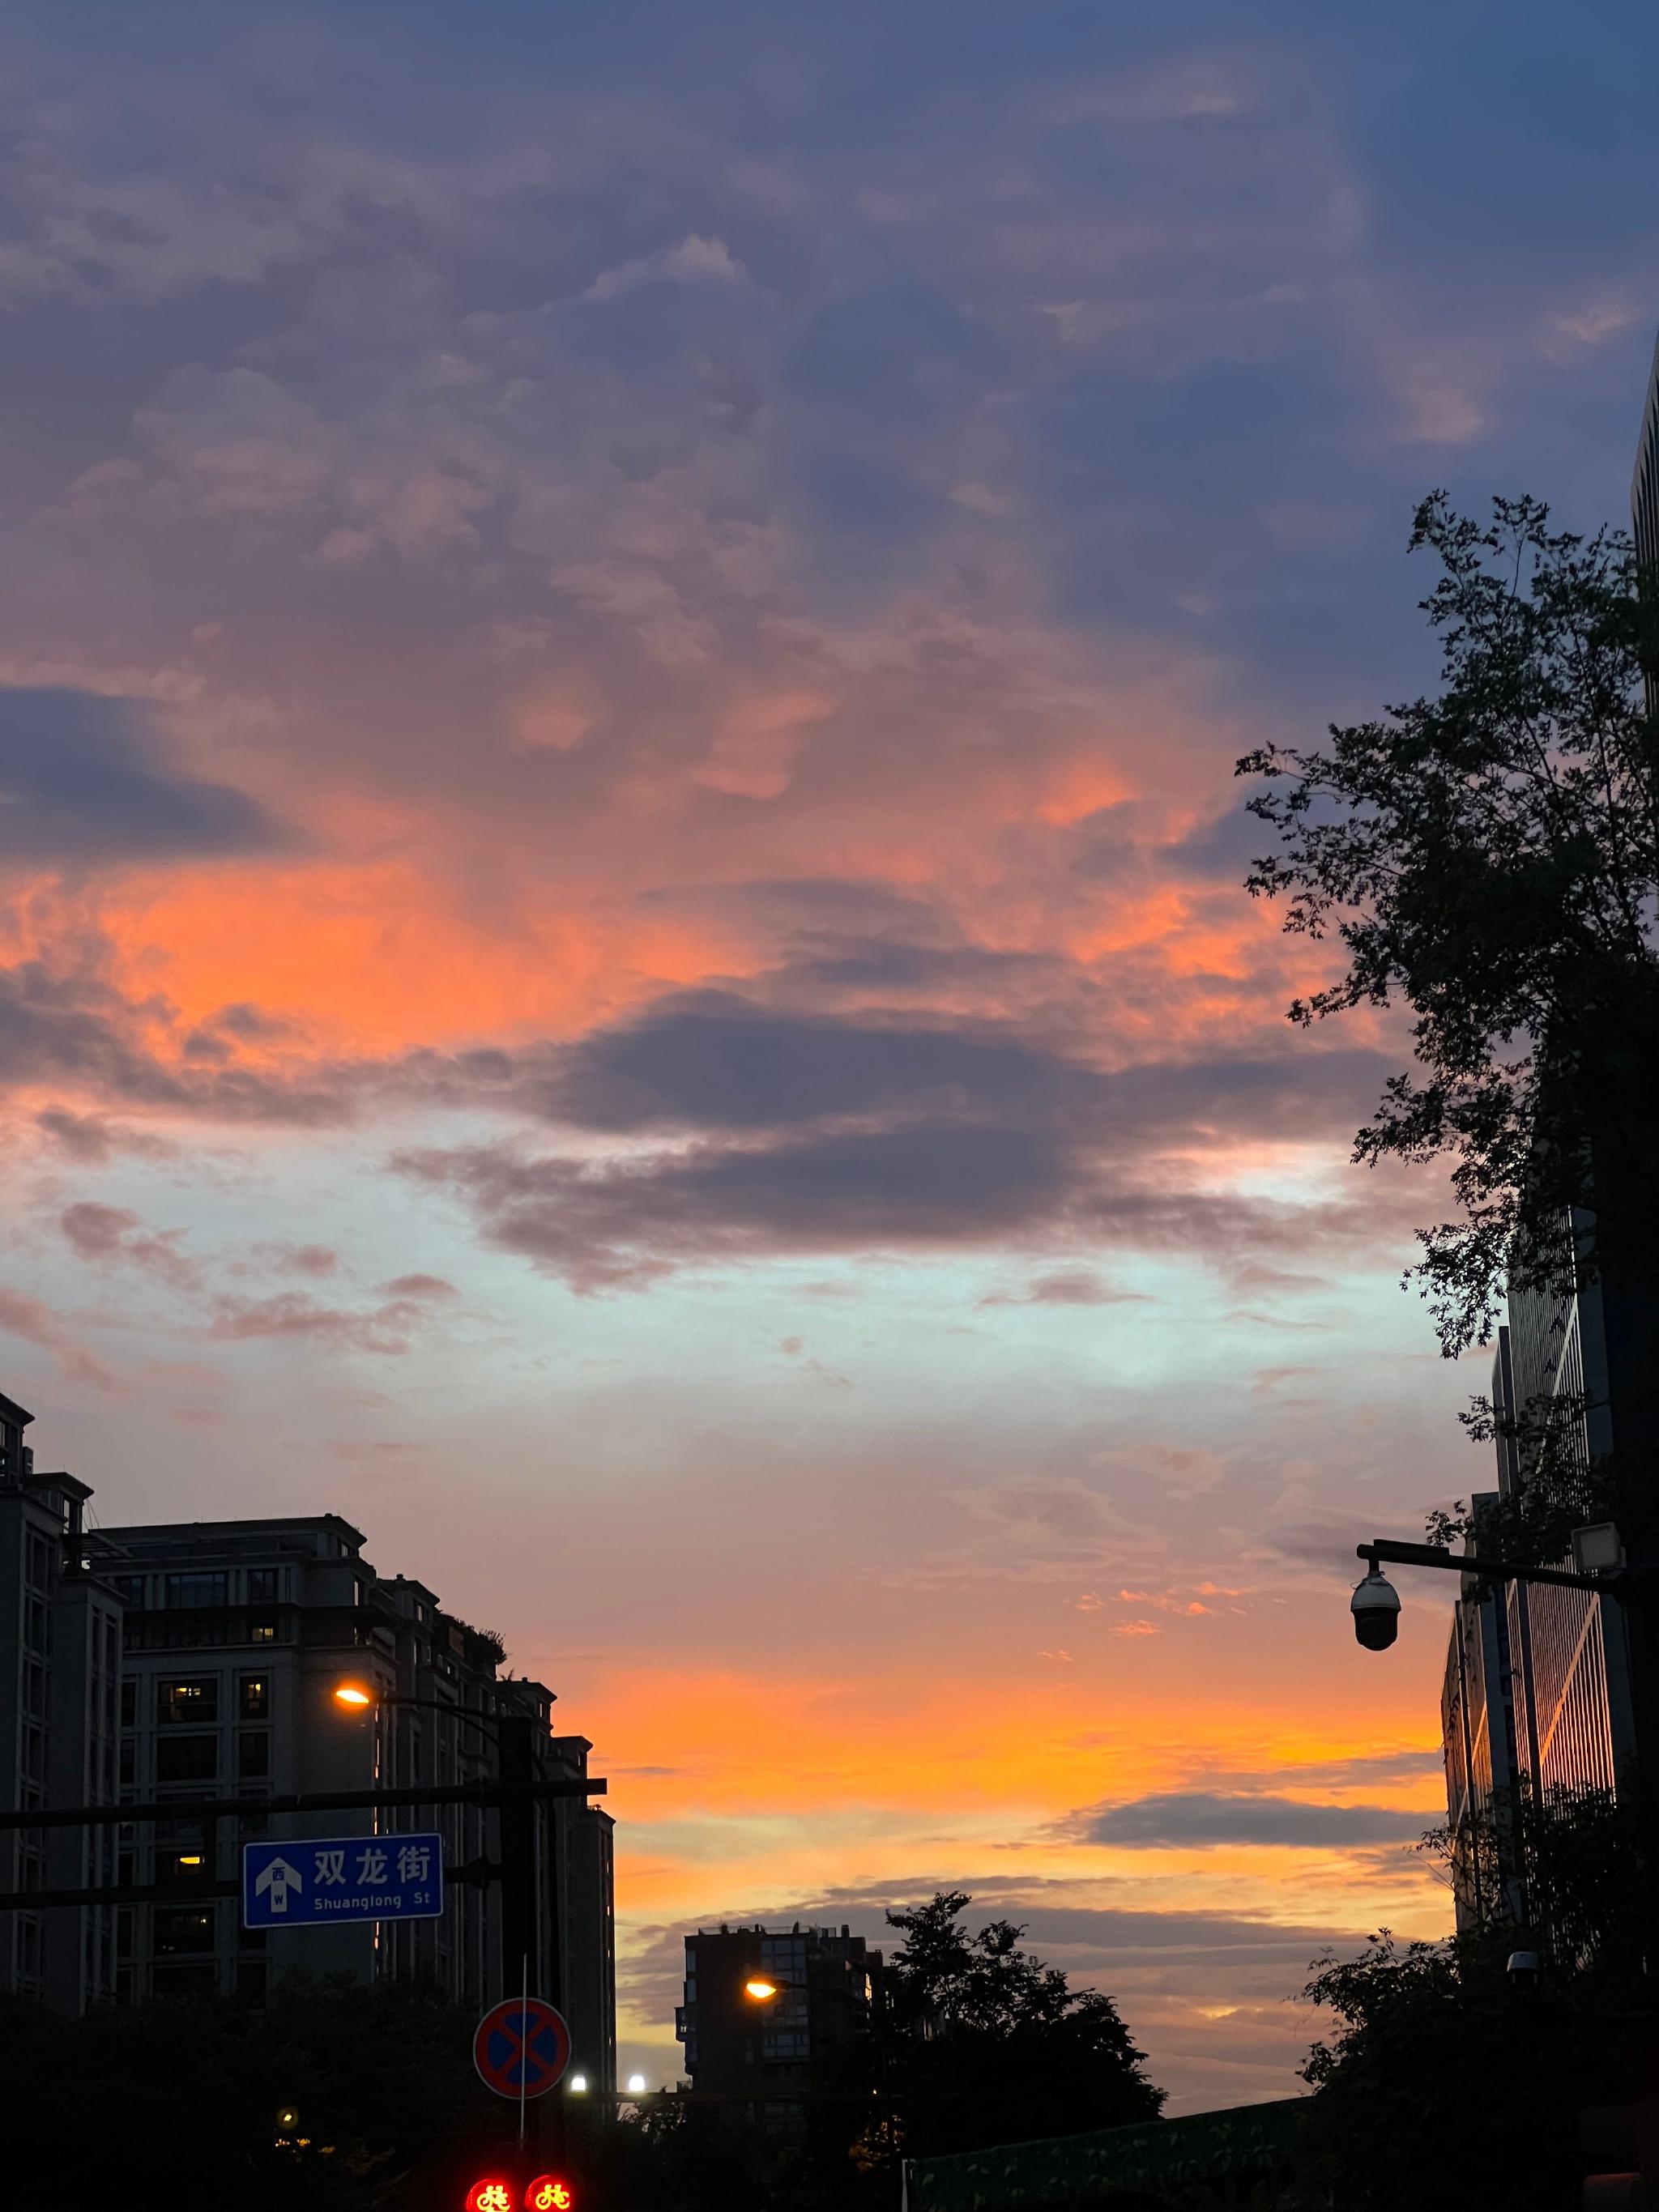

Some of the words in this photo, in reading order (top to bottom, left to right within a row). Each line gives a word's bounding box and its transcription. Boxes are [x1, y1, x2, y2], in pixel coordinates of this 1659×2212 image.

[272, 1867, 286, 1881] 西
[313, 1846, 430, 1886] 双龙街
[274, 1894, 284, 1905] W
[313, 1894, 402, 1911] Shuanglong
[413, 1891, 430, 1904] St
